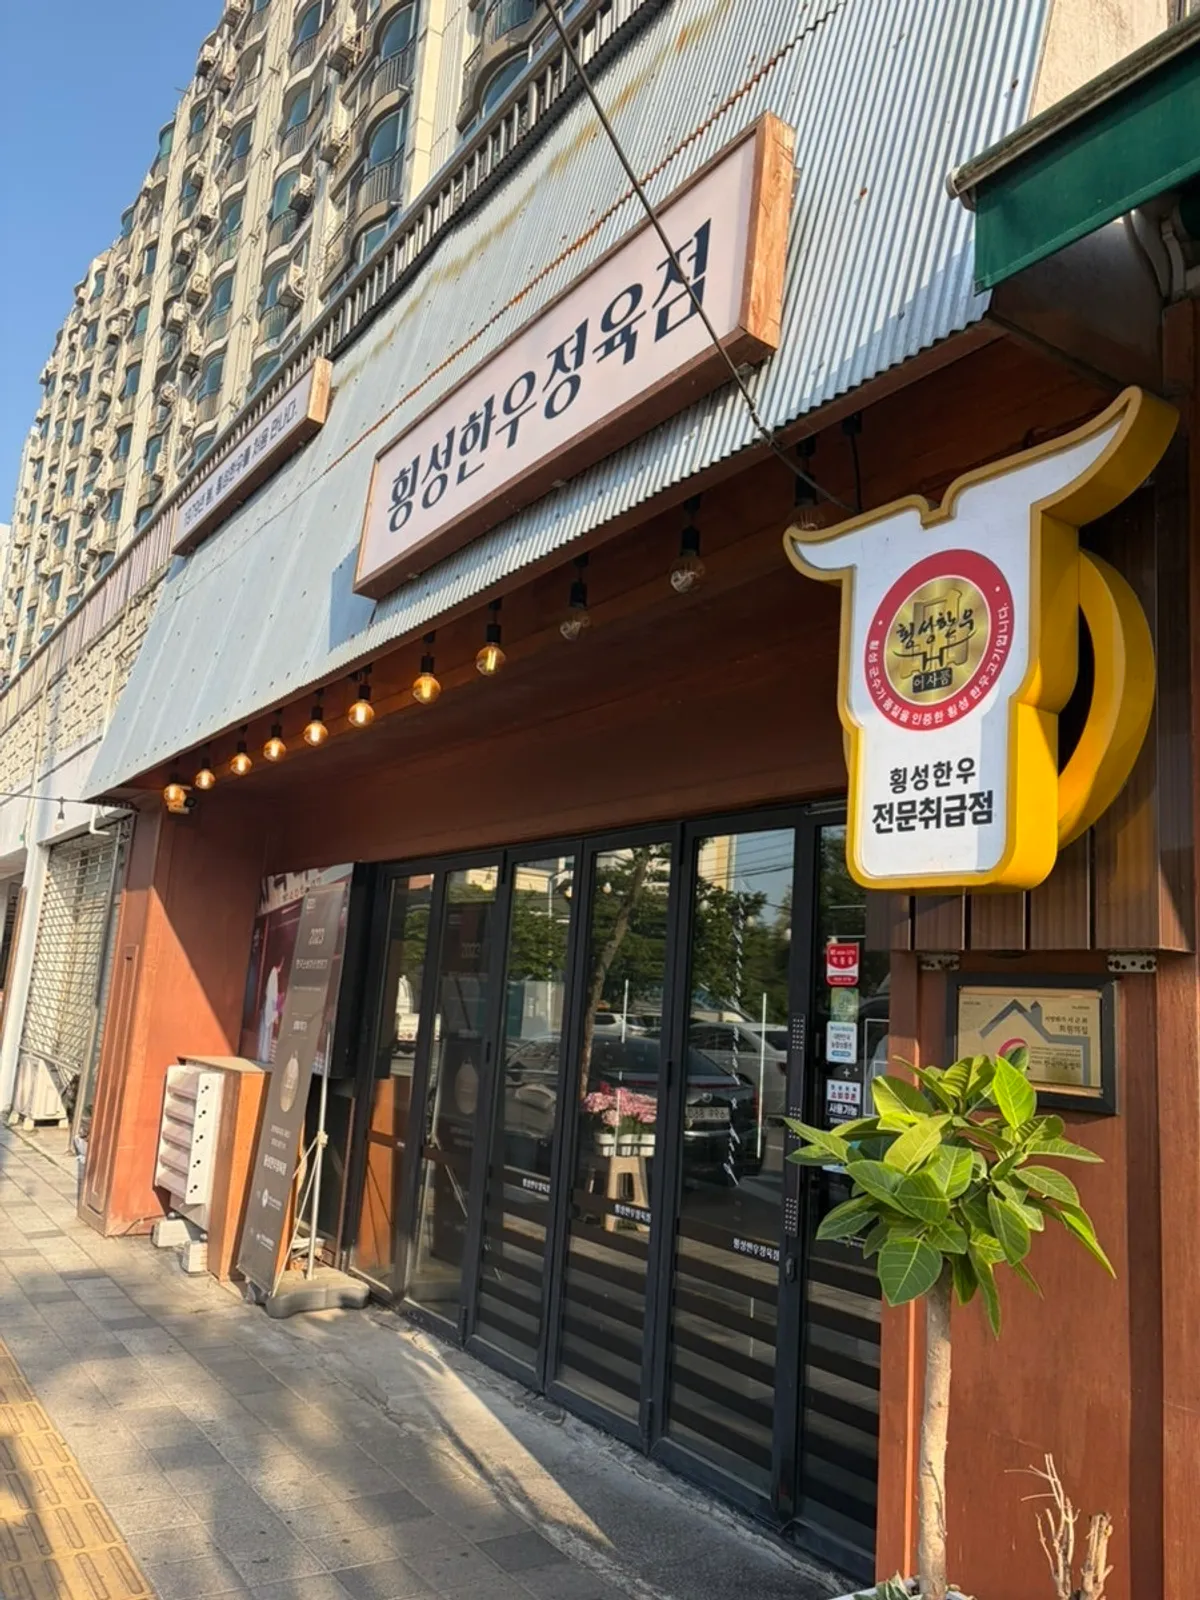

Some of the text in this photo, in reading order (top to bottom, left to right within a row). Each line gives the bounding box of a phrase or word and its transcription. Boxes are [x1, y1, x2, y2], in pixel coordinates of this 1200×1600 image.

[387, 217, 712, 533] 횡성한우정육점
[896, 608, 974, 650] 횡성한우
[868, 668, 887, 700] 군수가
[882, 698, 910, 724] 품질을
[912, 711, 944, 727] 인증한
[914, 670, 951, 690] 어사품
[889, 757, 976, 795] 횡성한우
[872, 789, 994, 835] 전문취급점
[828, 1103, 858, 1116] 사용가능
[733, 1237, 780, 1262] 횡성한우정육점
